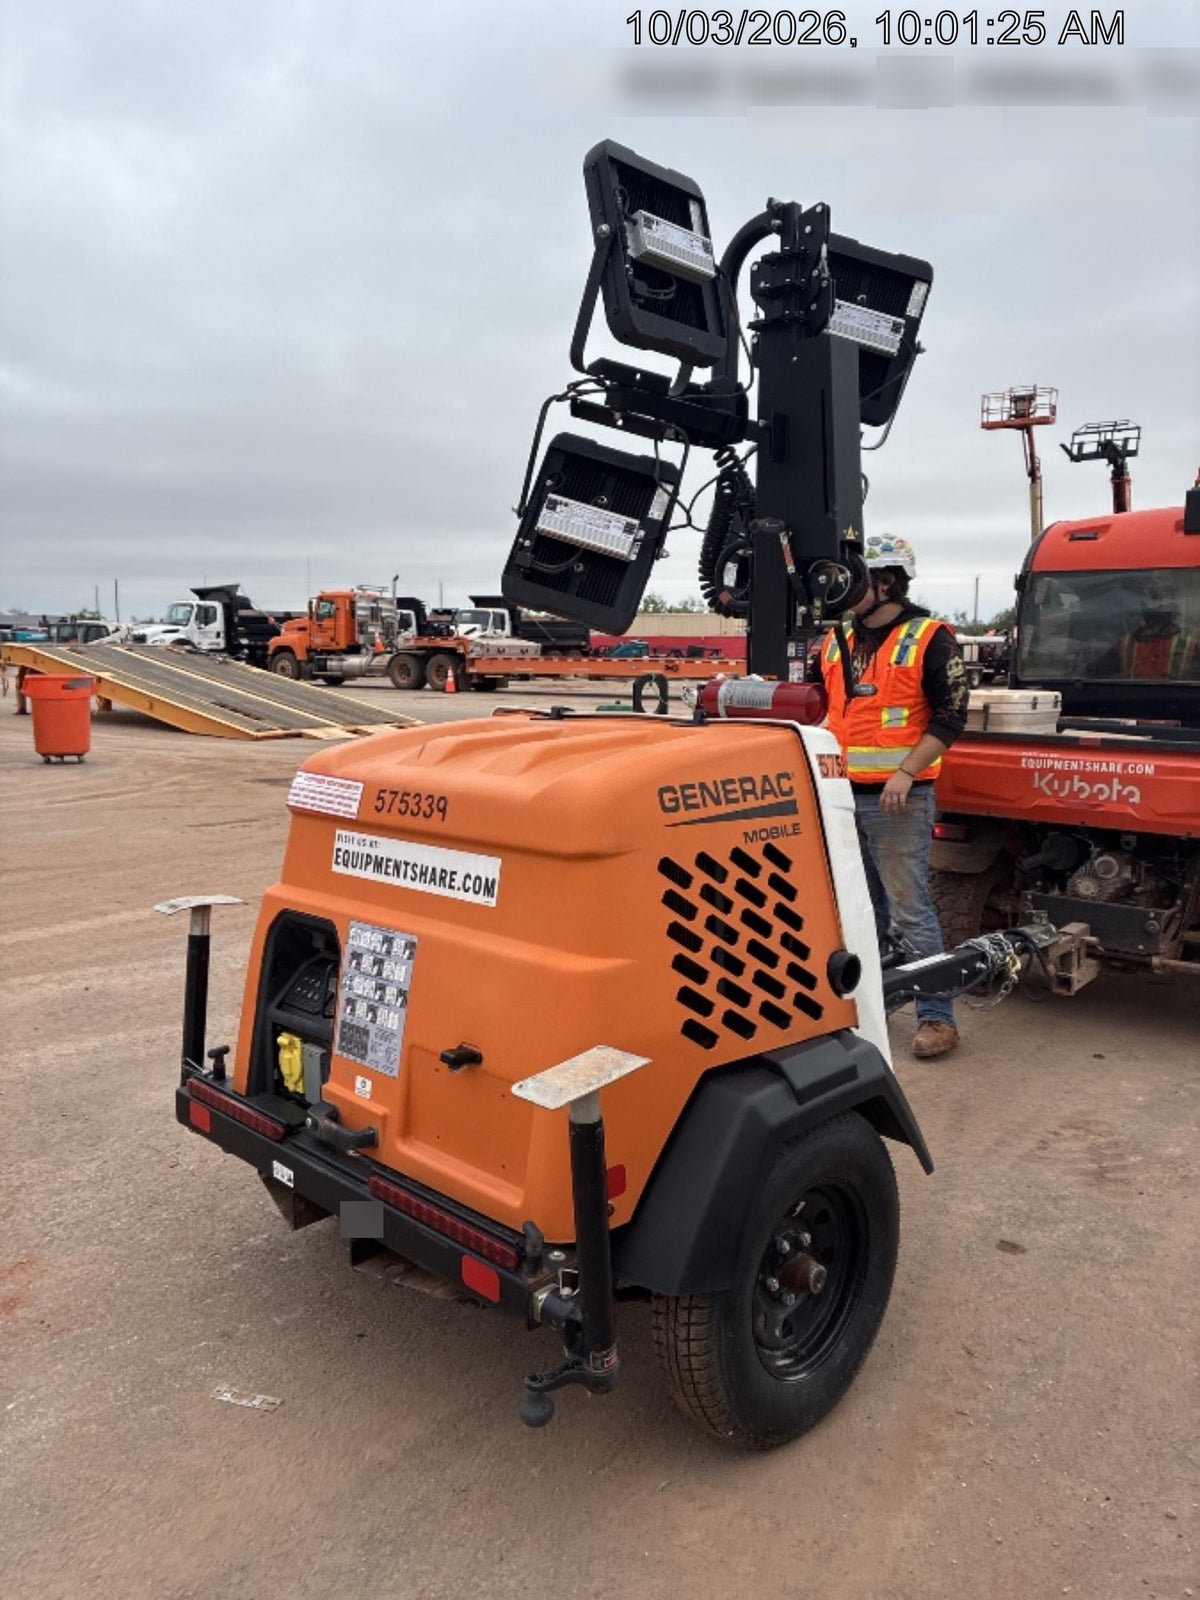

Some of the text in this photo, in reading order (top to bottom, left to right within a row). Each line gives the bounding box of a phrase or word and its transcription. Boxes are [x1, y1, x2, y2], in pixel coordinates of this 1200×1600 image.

[1021, 758, 1155, 775] EQUIPMENTSHARE.COM
[657, 772, 794, 813] GENERAC
[1033, 771, 1141, 804] Kubota
[374, 789, 448, 822] 575339
[337, 833, 355, 845] VISIT
[743, 823, 802, 843] MOBILE
[333, 847, 497, 899] EQUIPMENTSHARE.COM
